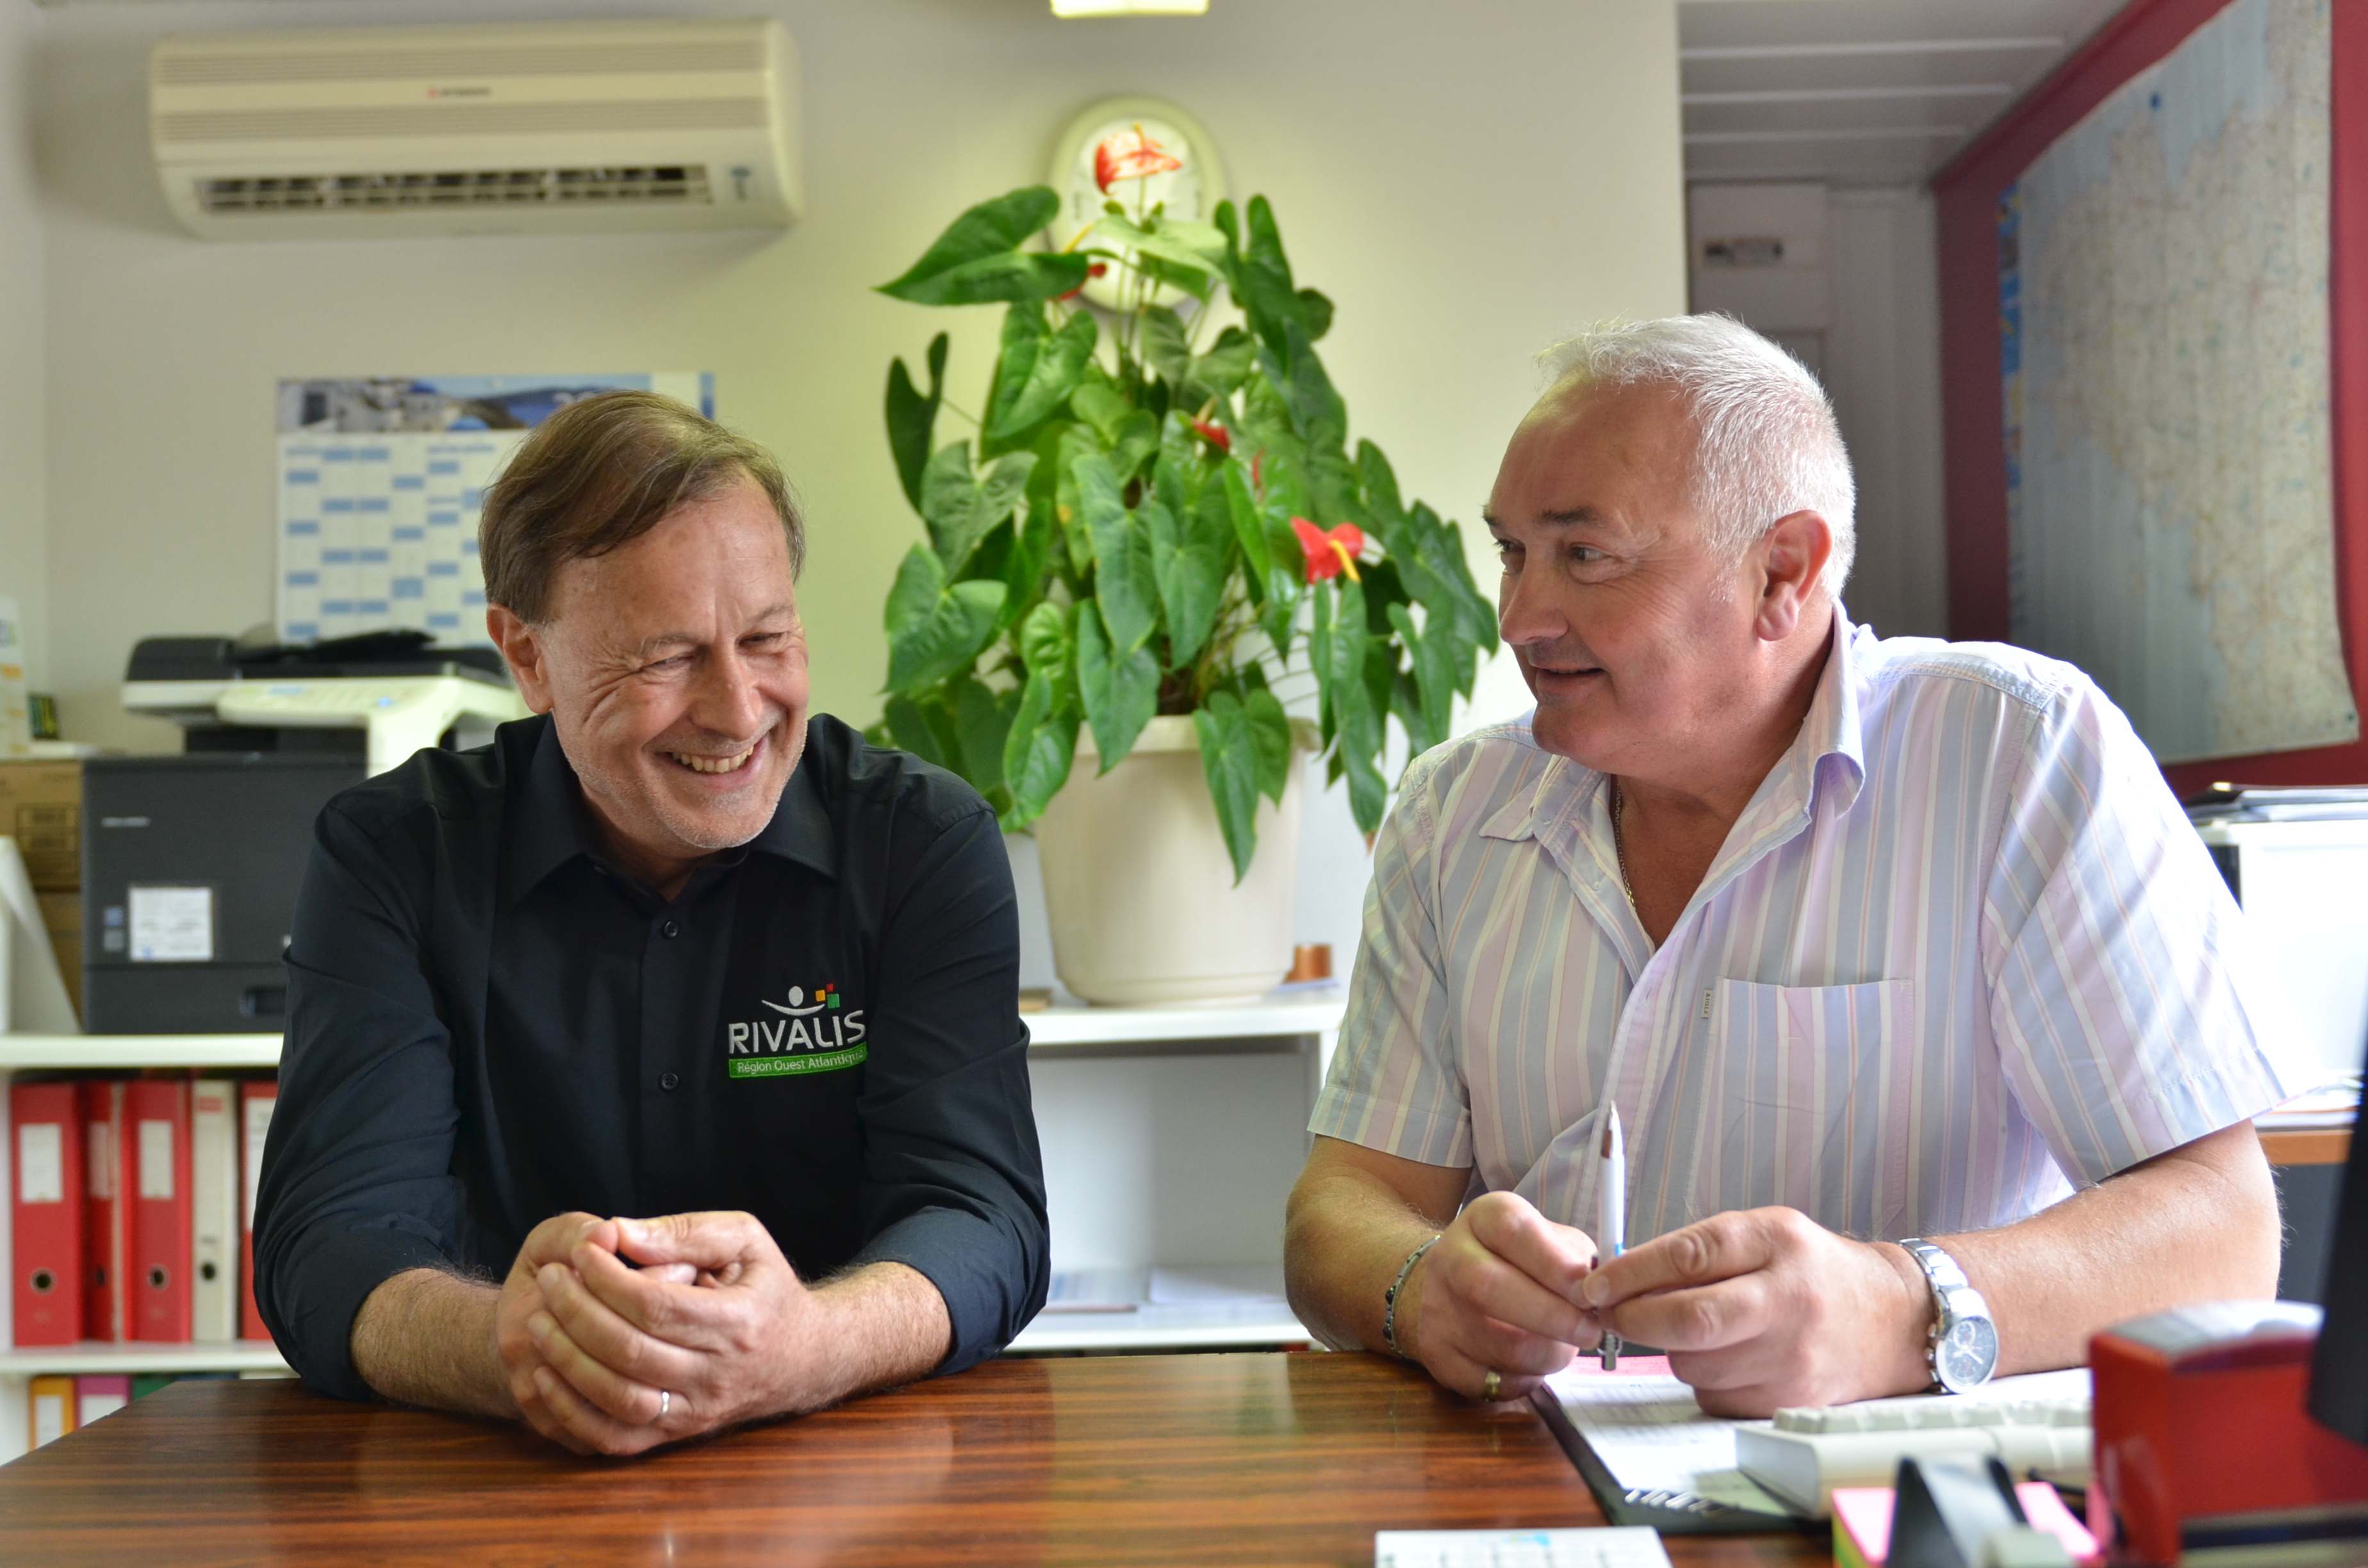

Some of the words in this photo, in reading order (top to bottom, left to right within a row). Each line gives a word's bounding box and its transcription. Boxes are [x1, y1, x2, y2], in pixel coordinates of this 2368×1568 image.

[728, 1010, 866, 1054] RIVALIS
[737, 1061, 772, 1075] Région
[774, 1060, 806, 1071] Ouest
